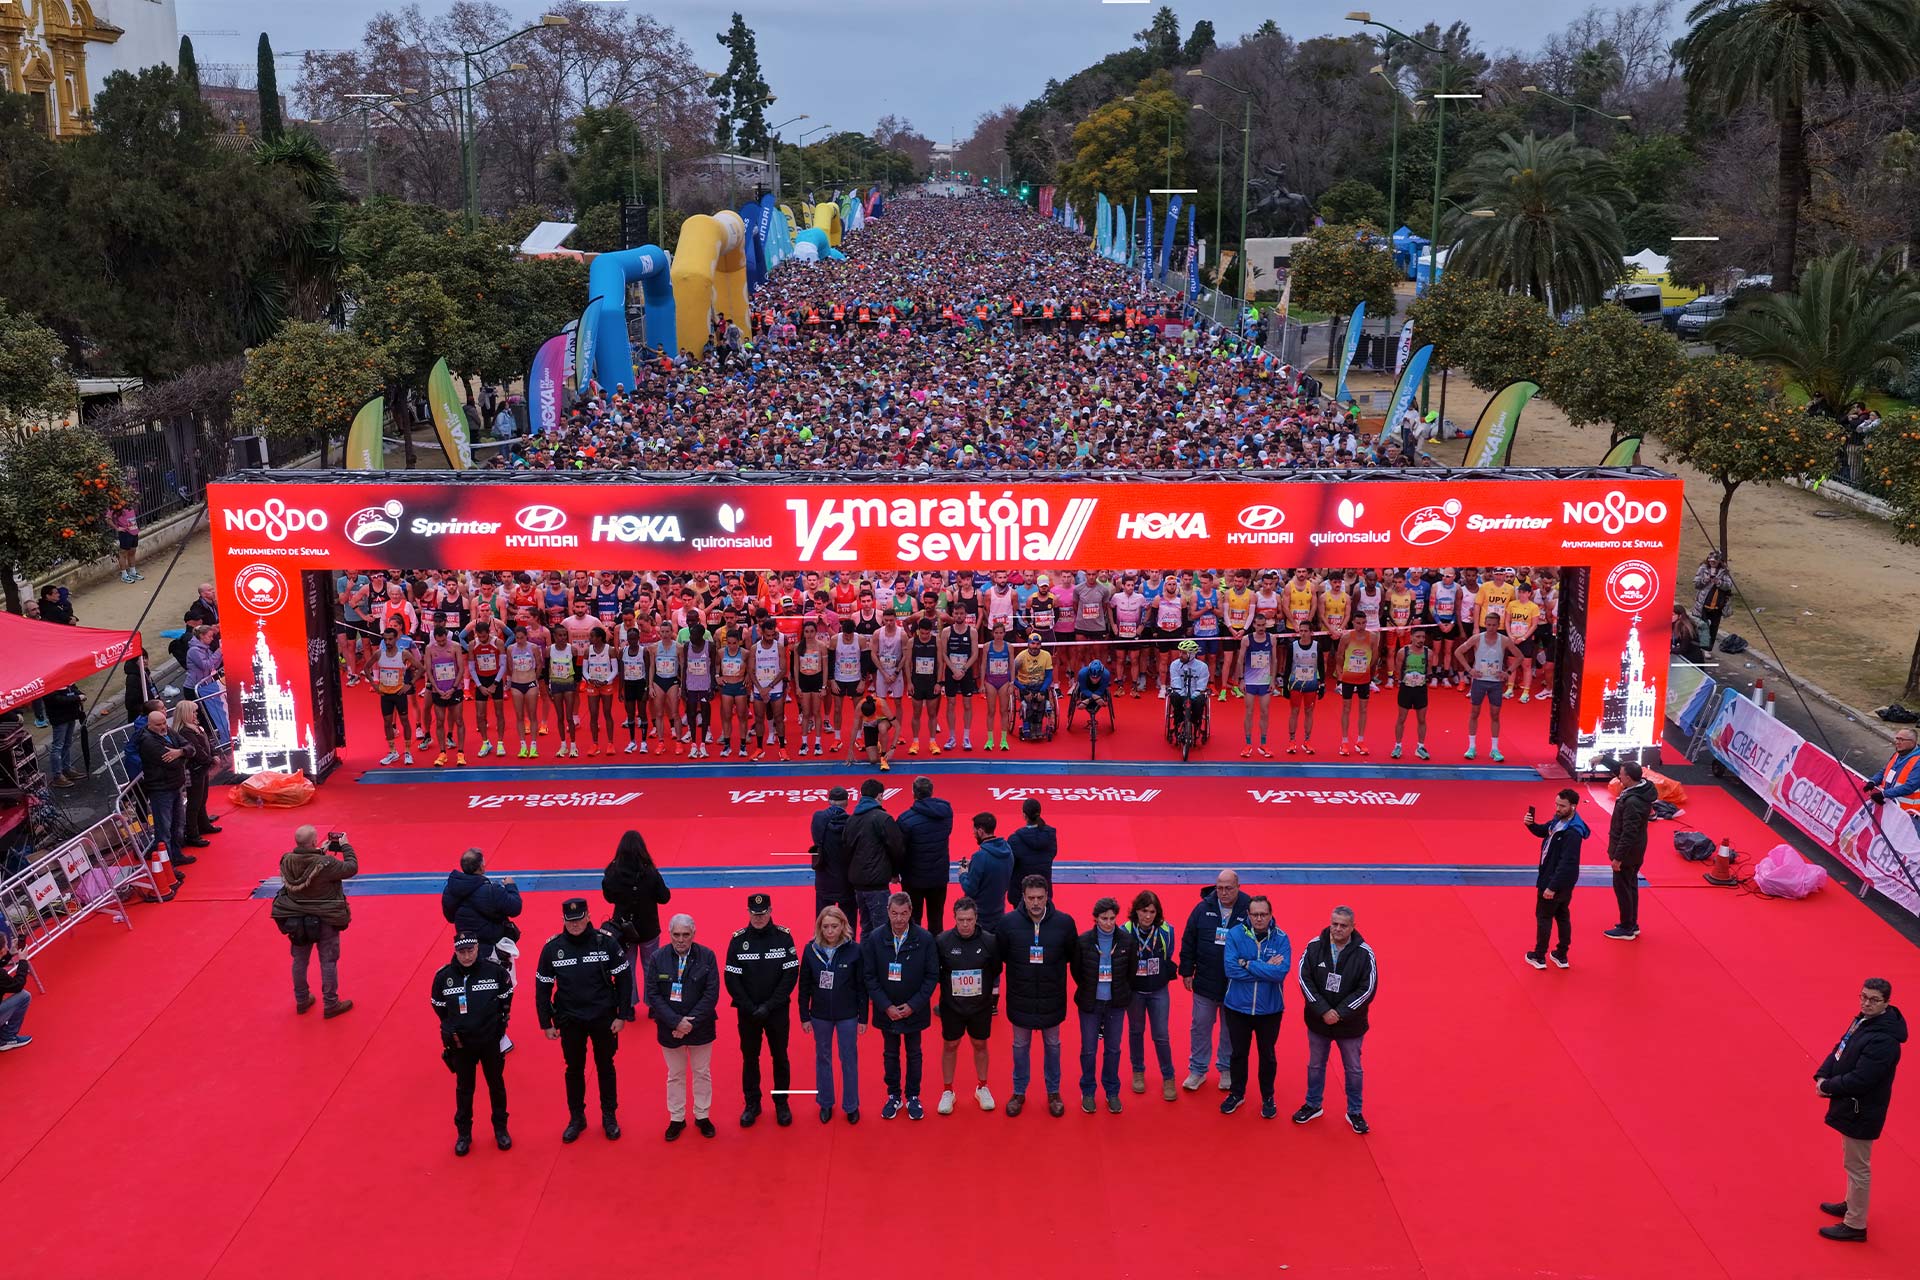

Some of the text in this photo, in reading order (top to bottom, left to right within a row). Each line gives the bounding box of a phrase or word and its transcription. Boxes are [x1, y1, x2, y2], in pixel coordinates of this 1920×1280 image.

[846, 491, 1049, 527] maratón
[410, 517, 501, 537] Sprinter
[591, 514, 683, 542] HOKA
[1117, 512, 1208, 540] HOKA
[1466, 515, 1553, 532] Sprinter
[506, 535, 578, 547] HYUNDAI
[691, 535, 773, 551] quirónsalud
[896, 521, 1052, 562] sevilla
[1227, 533, 1294, 545] HYUNDAI
[1309, 530, 1391, 546] quirónsalud
[1621, 540, 1633, 548] DE
[1634, 539, 1664, 548] SEVILLA
[288, 547, 298, 556] DE
[300, 547, 330, 557] SEVILLA
[1488, 596, 1506, 605] UPV
[1731, 730, 1774, 774] CREATE
[500, 791, 616, 801] maratón
[1020, 786, 1136, 795] maratón
[1279, 789, 1397, 799] maratón
[524, 798, 614, 807] sevilla
[1050, 792, 1140, 802] sevilla
[1312, 796, 1400, 805] sevilla
[1791, 780, 1845, 829] CREATE
[958, 975, 974, 985] 100
